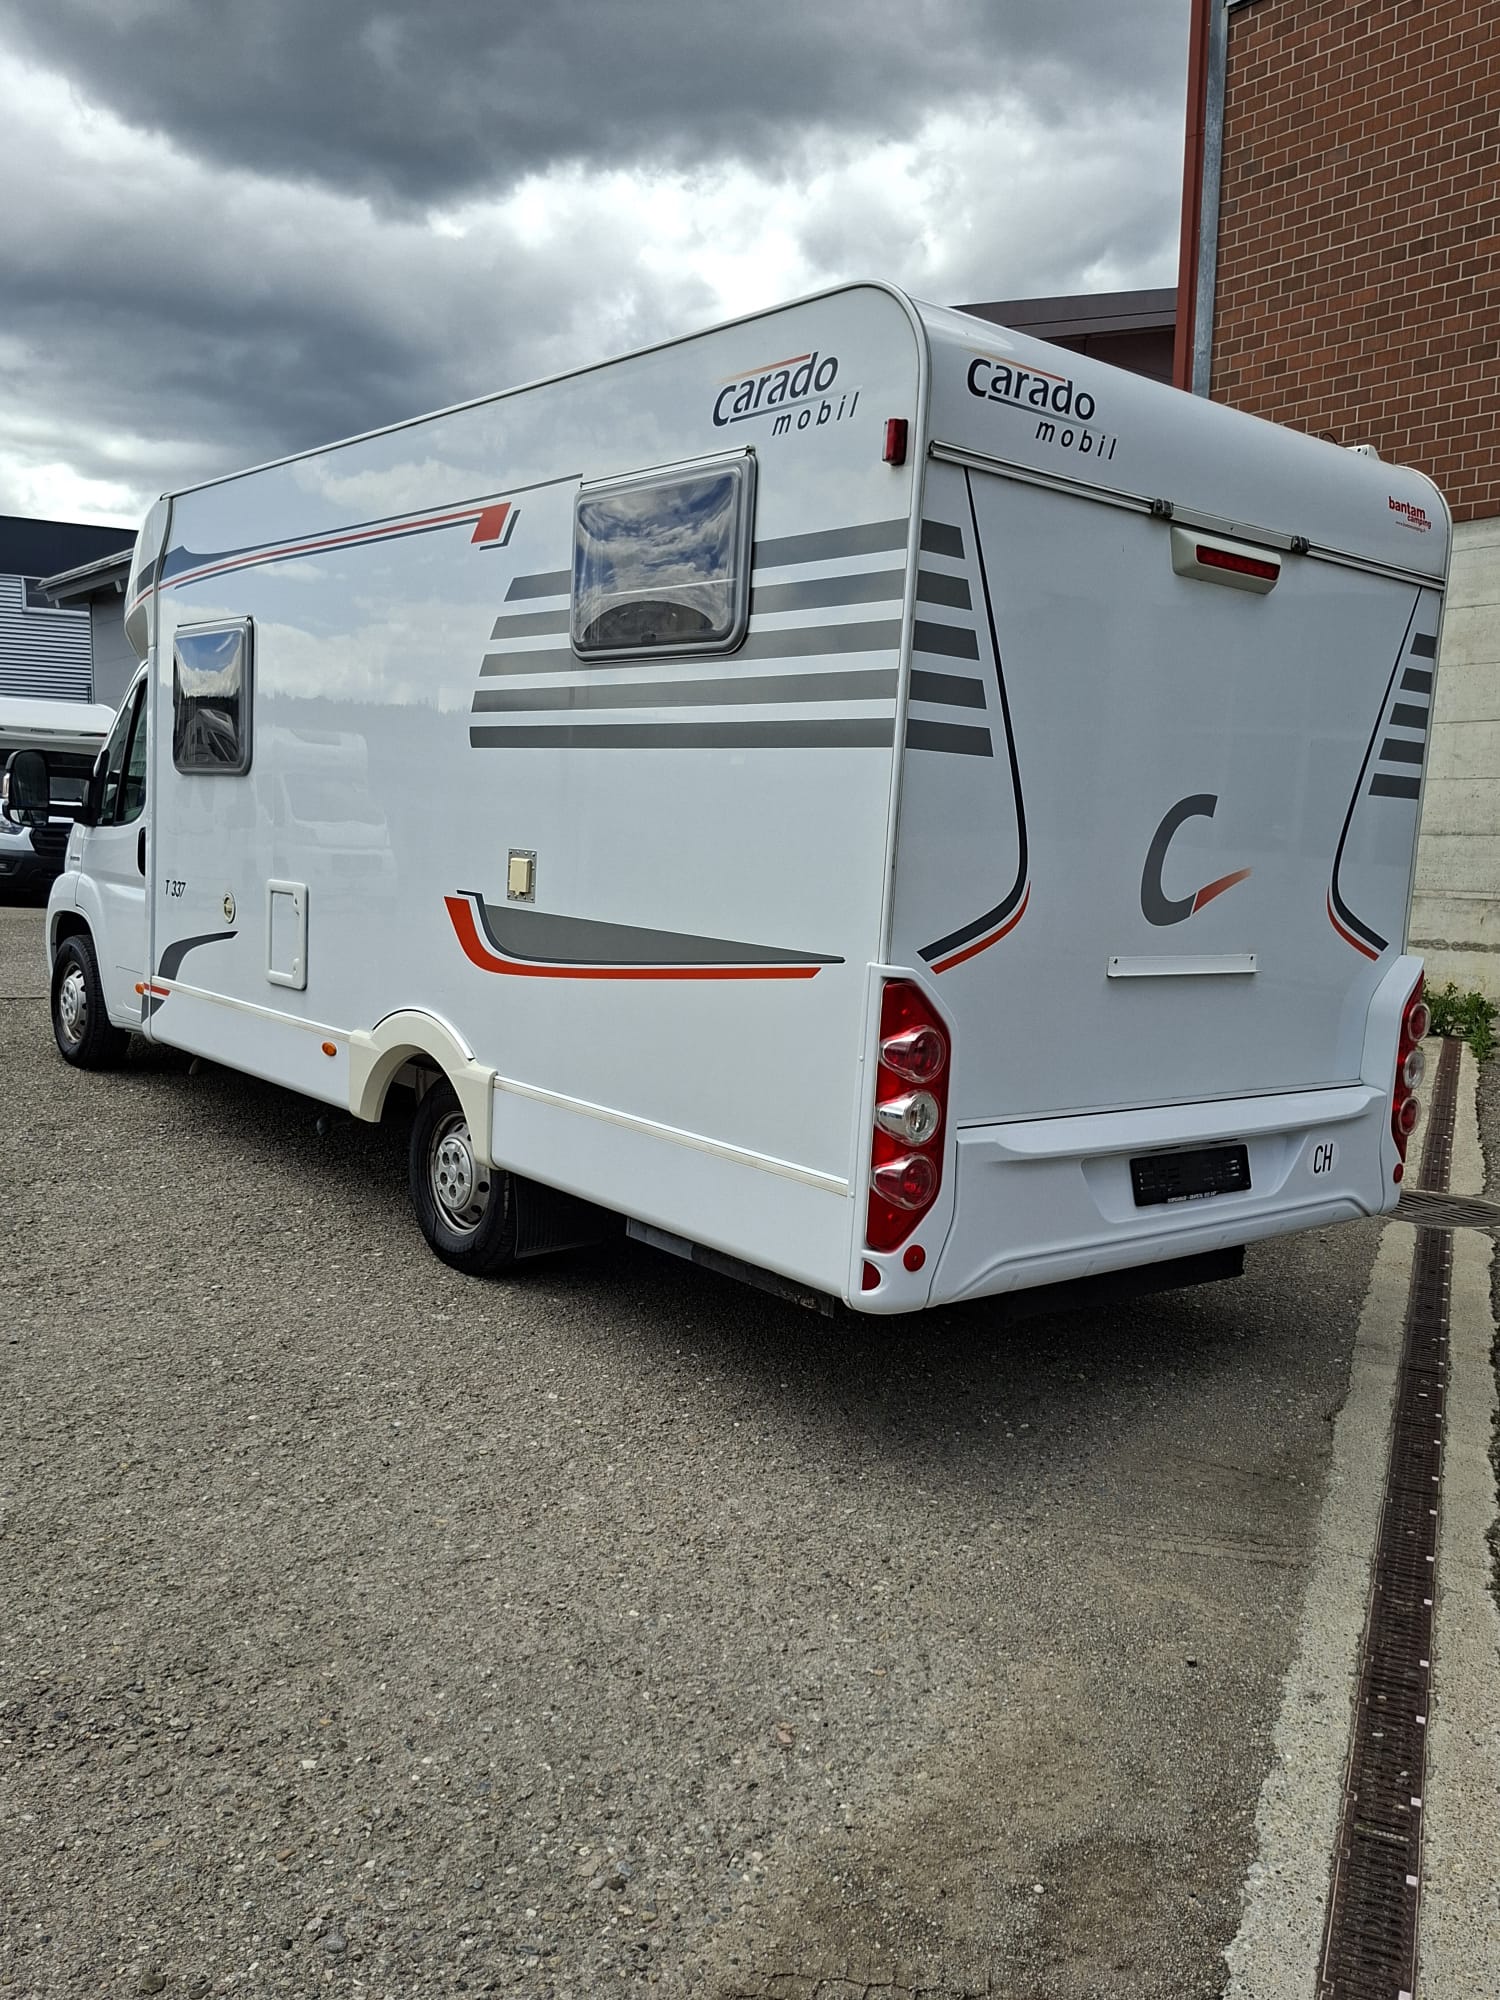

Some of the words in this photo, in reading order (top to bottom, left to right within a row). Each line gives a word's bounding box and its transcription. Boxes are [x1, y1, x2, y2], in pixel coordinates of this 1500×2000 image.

[712, 351, 839, 427] Carado
[967, 357, 1096, 421] Carado
[772, 391, 861, 437] mobil
[1035, 421, 1119, 461] mobil
[1388, 495, 1426, 520] bantam
[165, 879, 171, 896] T
[171, 880, 187, 898] 337
[1313, 1143, 1334, 1174] CH
